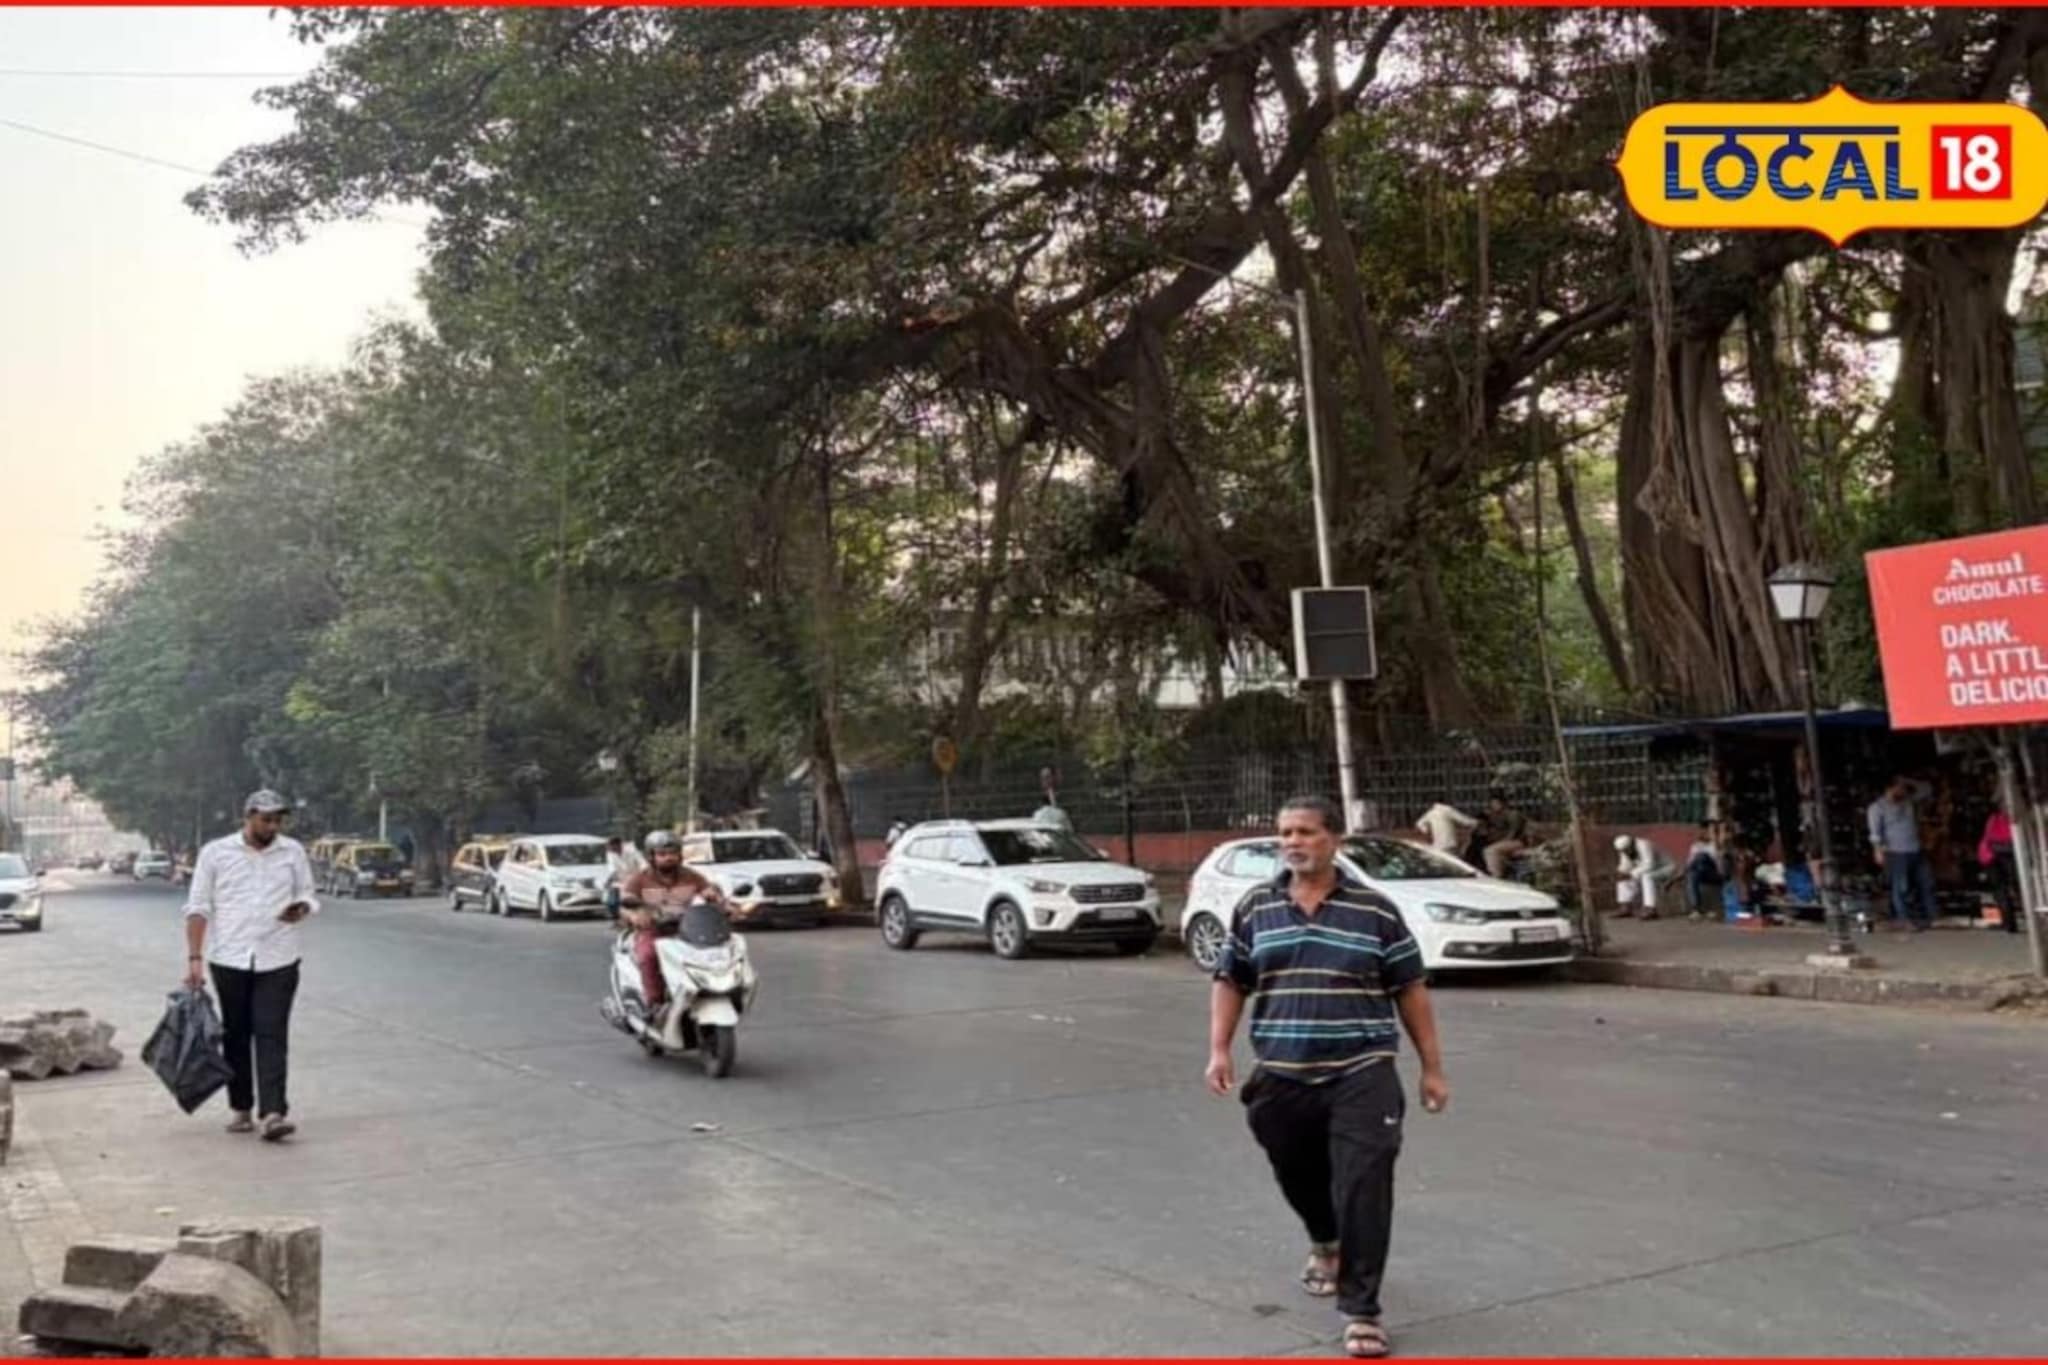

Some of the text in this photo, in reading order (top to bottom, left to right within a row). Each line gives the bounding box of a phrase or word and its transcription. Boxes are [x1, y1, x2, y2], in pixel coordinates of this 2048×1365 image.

[1946, 552, 2024, 580] Amul
[1932, 575, 2044, 605] CHOCOLATE
[1940, 619, 2020, 649] DARK.
[1946, 653, 1964, 678] A
